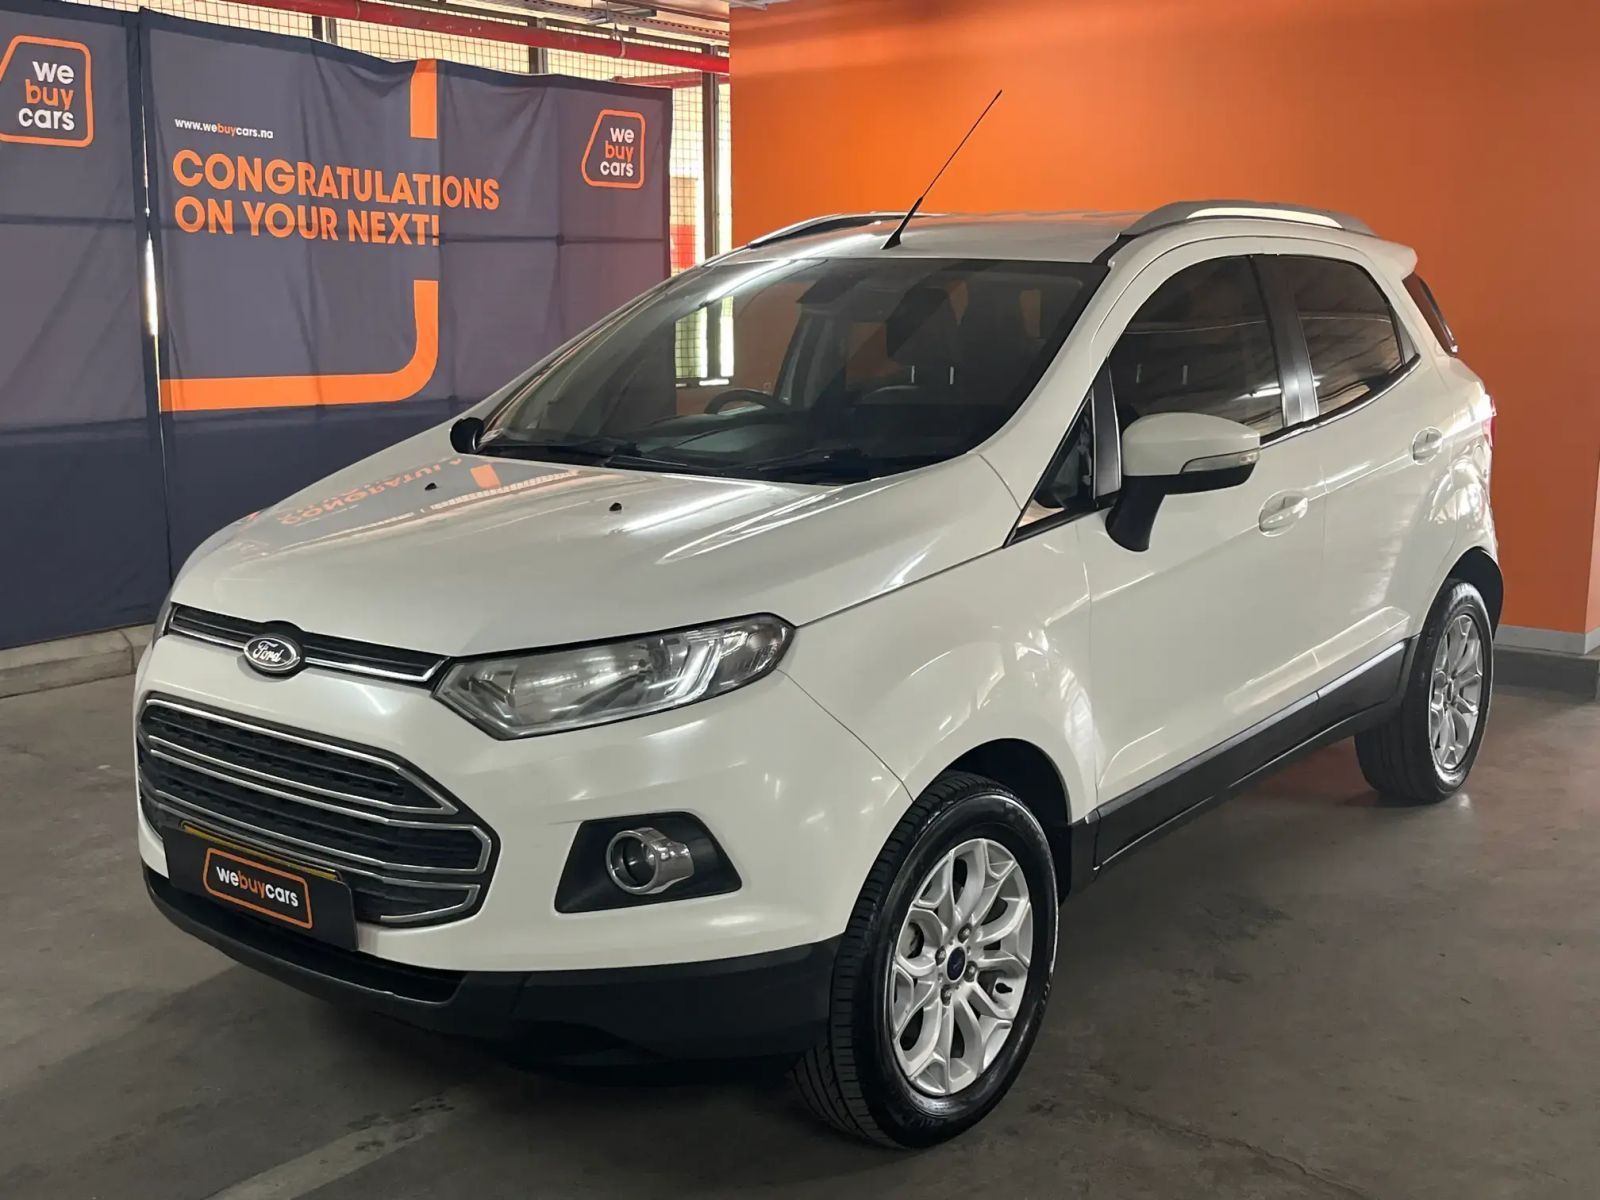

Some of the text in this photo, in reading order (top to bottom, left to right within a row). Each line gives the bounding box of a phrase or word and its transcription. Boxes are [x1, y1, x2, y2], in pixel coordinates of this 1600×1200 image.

[32, 60, 75, 85] we
[25, 78, 74, 111] buy
[18, 107, 75, 131] cars
[174, 118, 274, 139] www.webuycars.na
[609, 127, 635, 144] we
[605, 140, 634, 163] buy
[172, 149, 500, 210] CONGRATULATIONS
[600, 160, 634, 177] cars
[174, 195, 440, 247] ON YOUR NEXT!
[252, 640, 285, 663] Ford
[216, 865, 299, 908] webuycars
